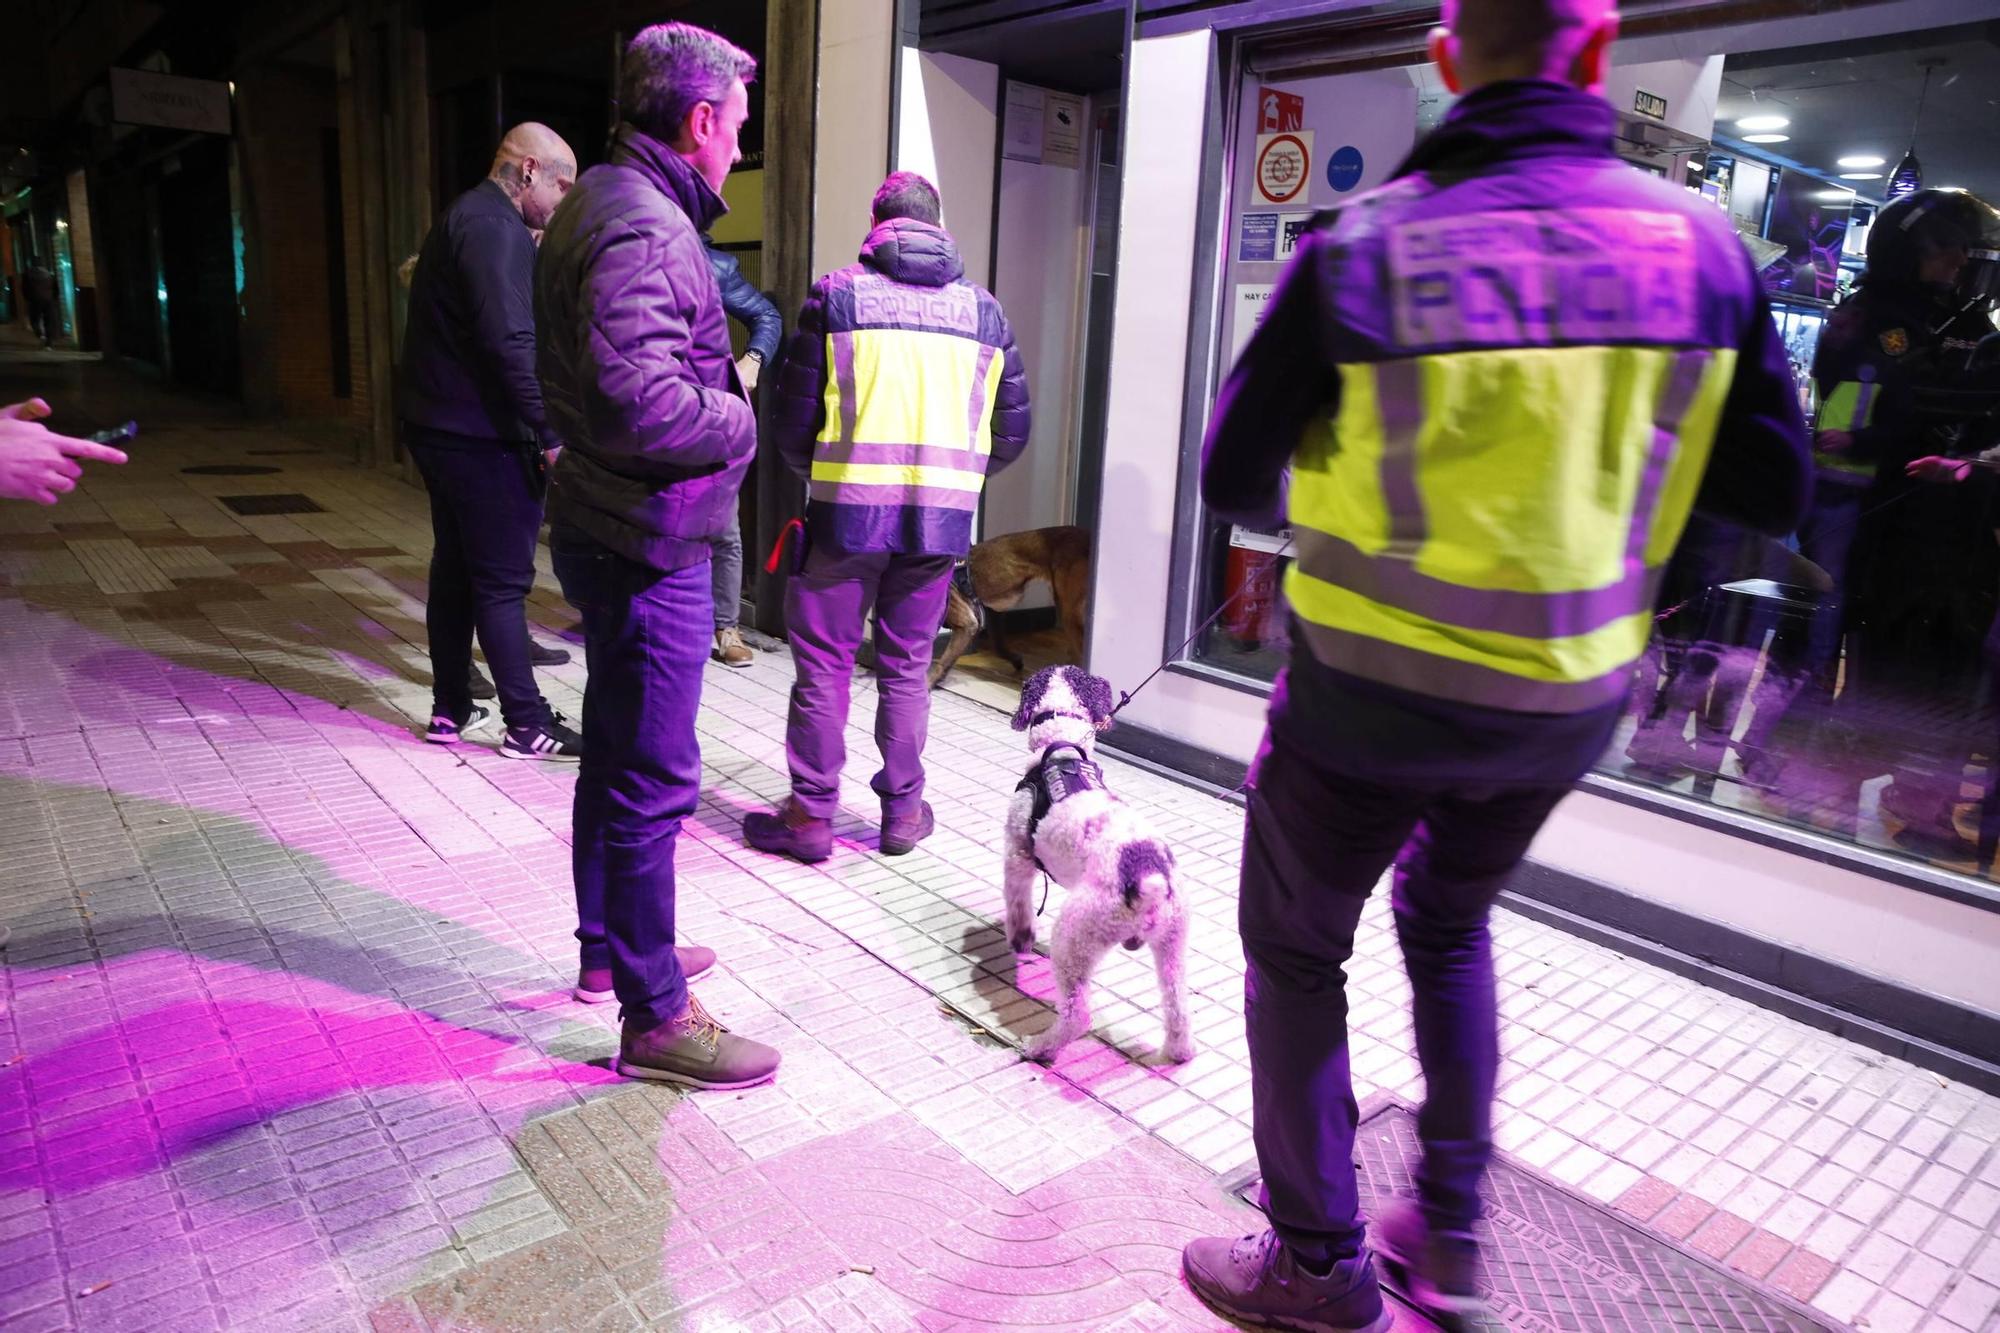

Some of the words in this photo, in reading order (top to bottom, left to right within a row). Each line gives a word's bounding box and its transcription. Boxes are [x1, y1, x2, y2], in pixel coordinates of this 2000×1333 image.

[1636, 91, 1666, 119] SALIDA
[860, 295, 975, 327] POLICIA
[1244, 293, 1260, 301] HAY
[1483, 1203, 1629, 1290] SANEAMIEN
